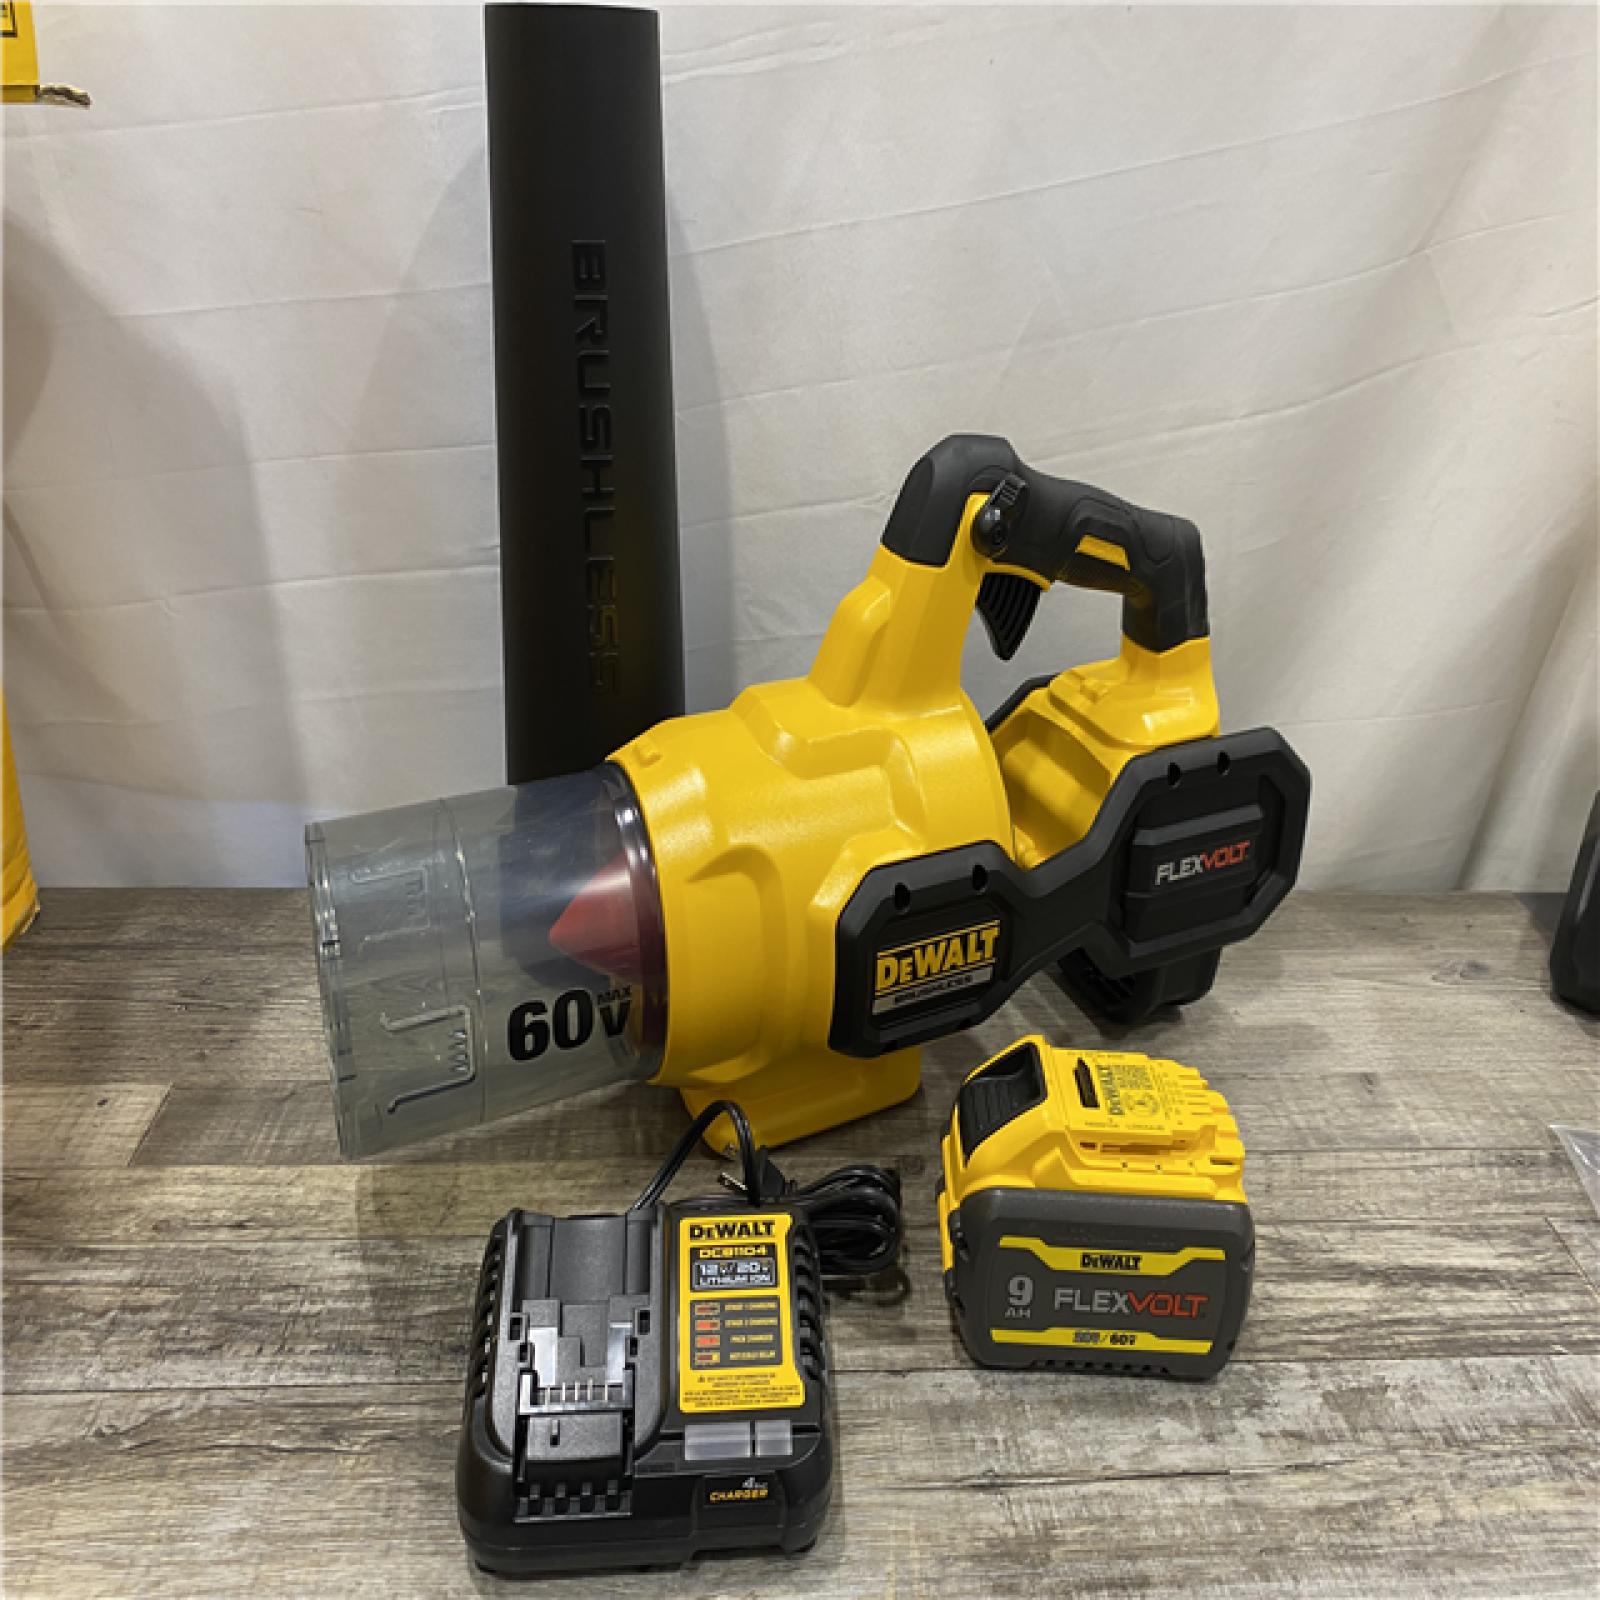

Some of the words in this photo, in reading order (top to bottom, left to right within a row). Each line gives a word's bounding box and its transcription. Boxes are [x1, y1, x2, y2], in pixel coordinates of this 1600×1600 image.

[571, 239, 622, 696] BRUSHLESS
[1155, 840, 1250, 886] FLEXVOLT
[1008, 1274, 1034, 1306] 9
[1054, 1286, 1209, 1319] FLEXVOLT
[709, 1489, 769, 1502] CHARGER
